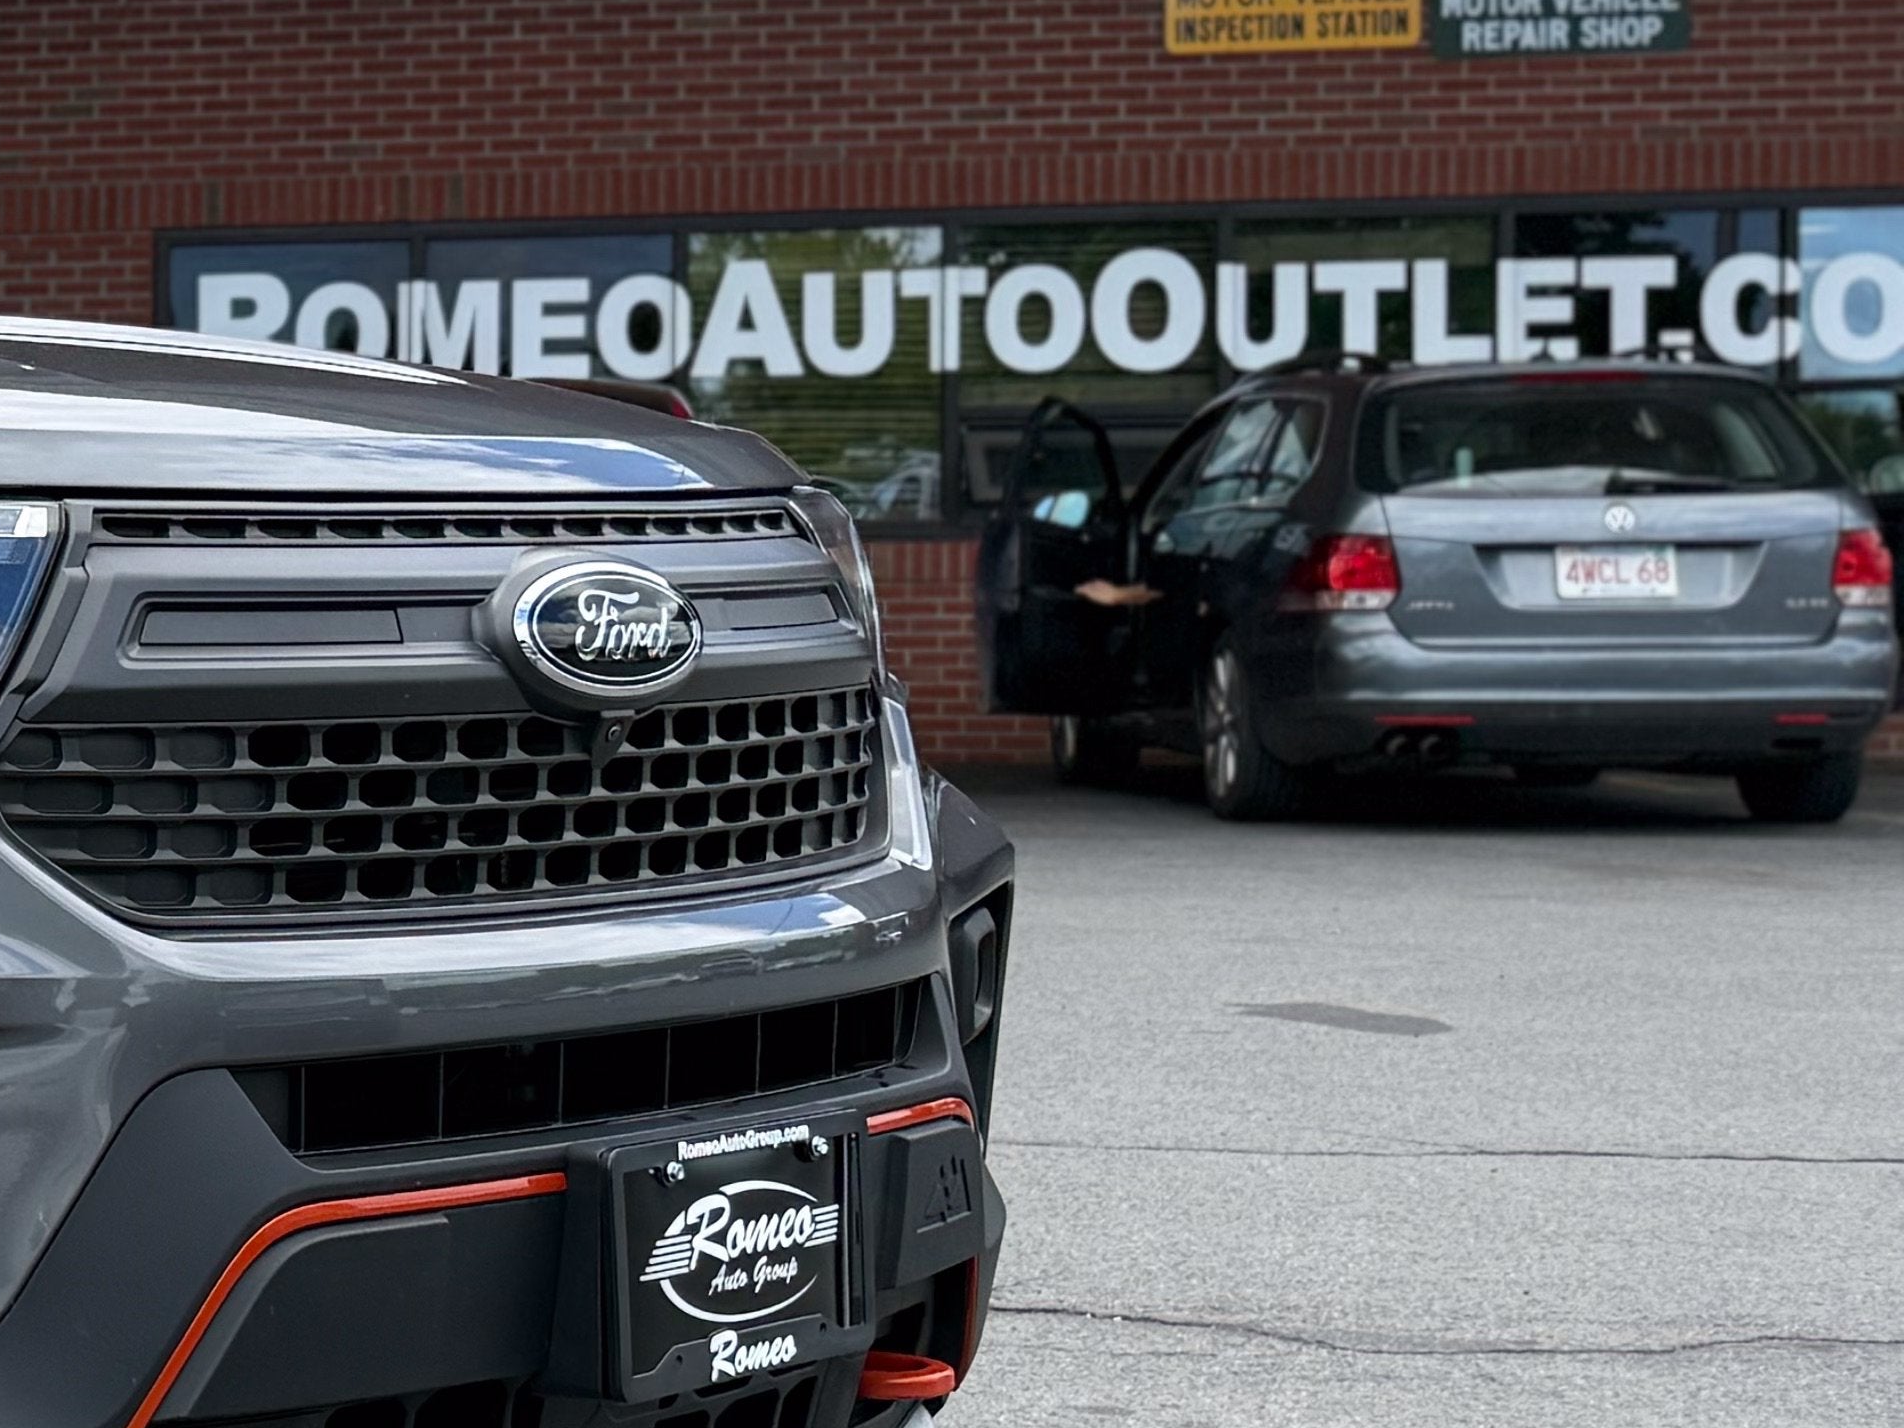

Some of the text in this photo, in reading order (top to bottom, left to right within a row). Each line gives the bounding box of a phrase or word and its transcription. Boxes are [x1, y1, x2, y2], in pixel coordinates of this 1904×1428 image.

[1175, 8, 1409, 44] INSPECTION STATION
[1462, 14, 1664, 52] REPAIR SHOP
[1565, 557, 1670, 585] 4WCL 68
[575, 589, 672, 661] Ford
[677, 1124, 810, 1161] RomeoAutoGroup.com
[685, 1193, 816, 1271] Romeo
[709, 1255, 799, 1296] Auto Group
[710, 1329, 797, 1382] Romeo
